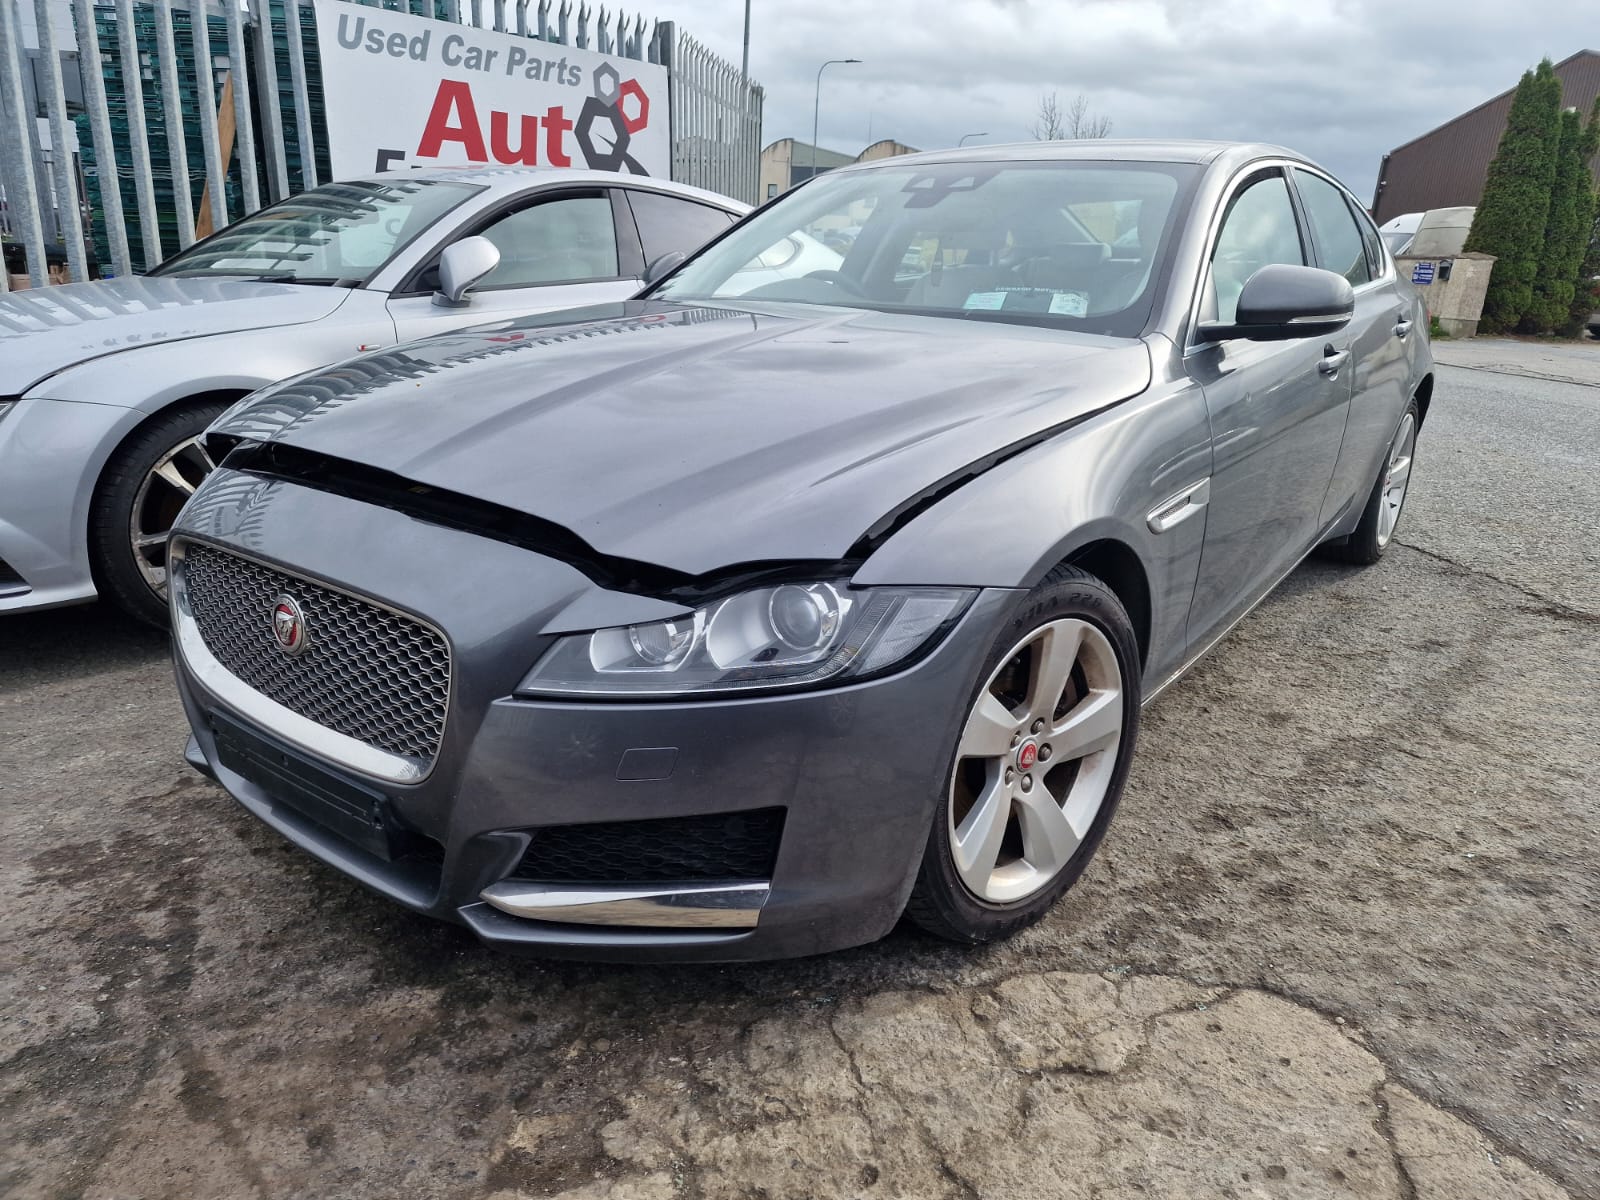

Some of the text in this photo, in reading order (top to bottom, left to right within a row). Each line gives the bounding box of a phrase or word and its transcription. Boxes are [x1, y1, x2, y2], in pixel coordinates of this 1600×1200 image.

[337, 13, 582, 86] Used Car Parts
